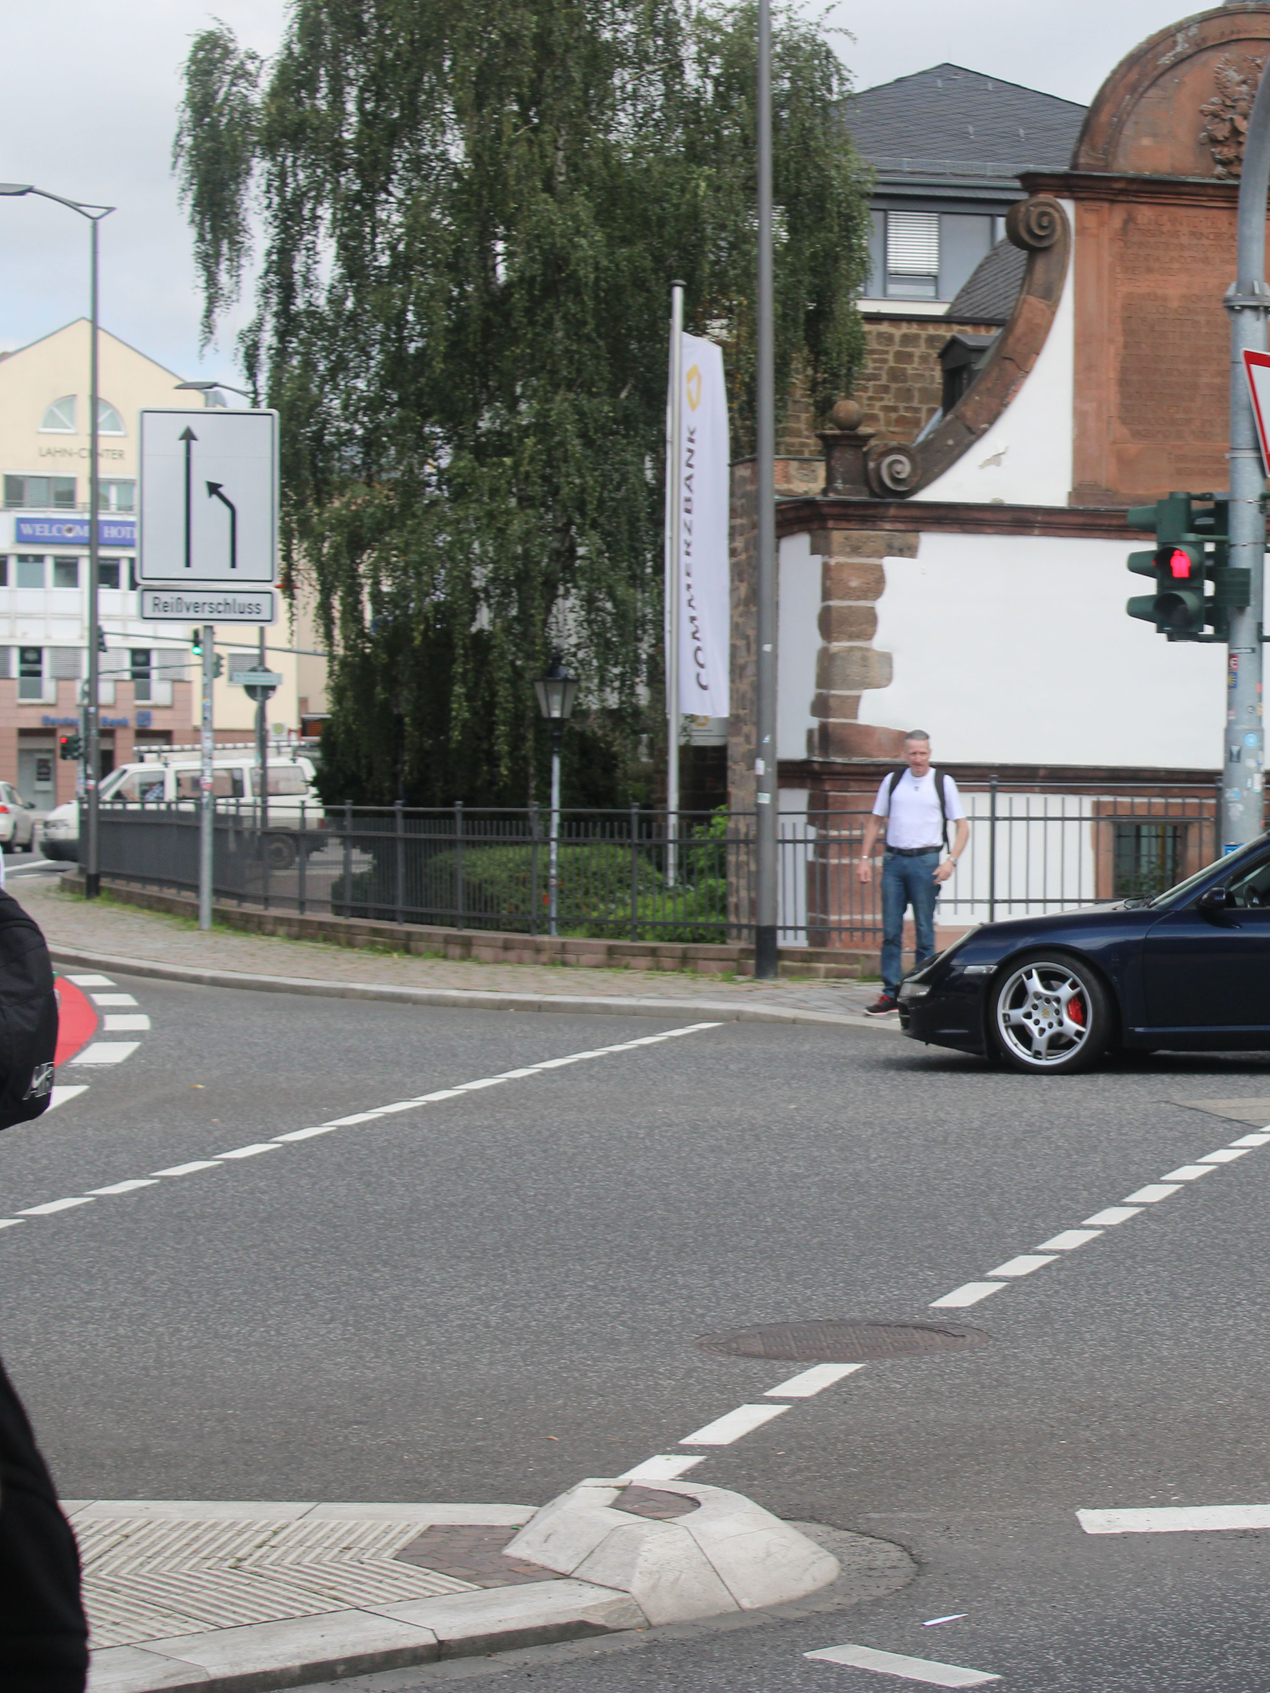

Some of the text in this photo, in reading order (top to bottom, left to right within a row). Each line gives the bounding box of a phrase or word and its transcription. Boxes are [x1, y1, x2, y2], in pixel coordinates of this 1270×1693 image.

[19, 523, 90, 537] WELCOM
[683, 426, 710, 691] COMMERZBANK
[152, 596, 262, 615] Reißverschluss
